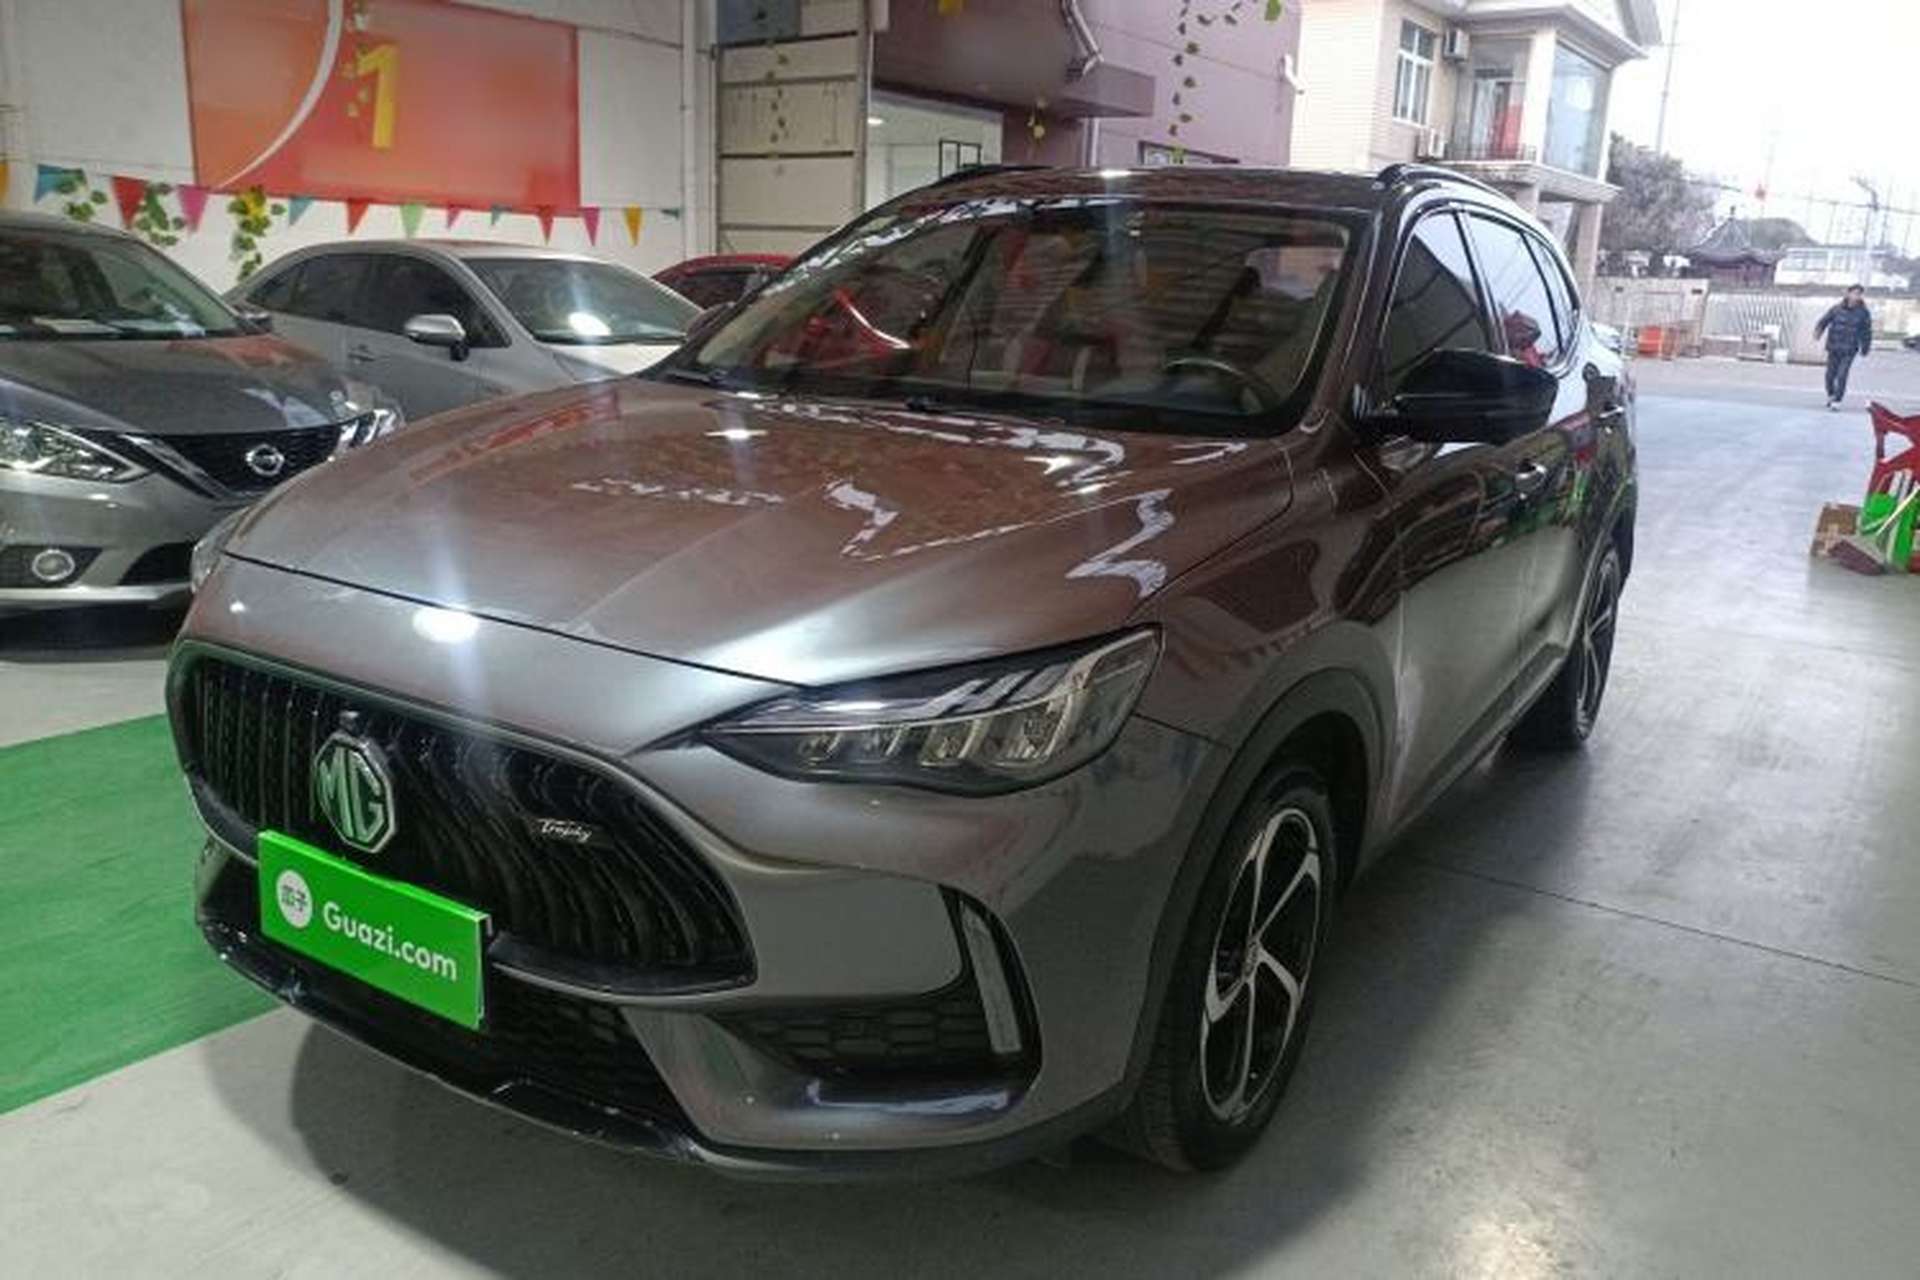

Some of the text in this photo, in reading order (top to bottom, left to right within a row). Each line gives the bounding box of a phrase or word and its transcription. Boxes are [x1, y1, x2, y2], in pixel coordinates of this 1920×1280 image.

[357, 44, 397, 149] 1
[318, 746, 384, 841] MG
[323, 902, 457, 981] Guazi.com
